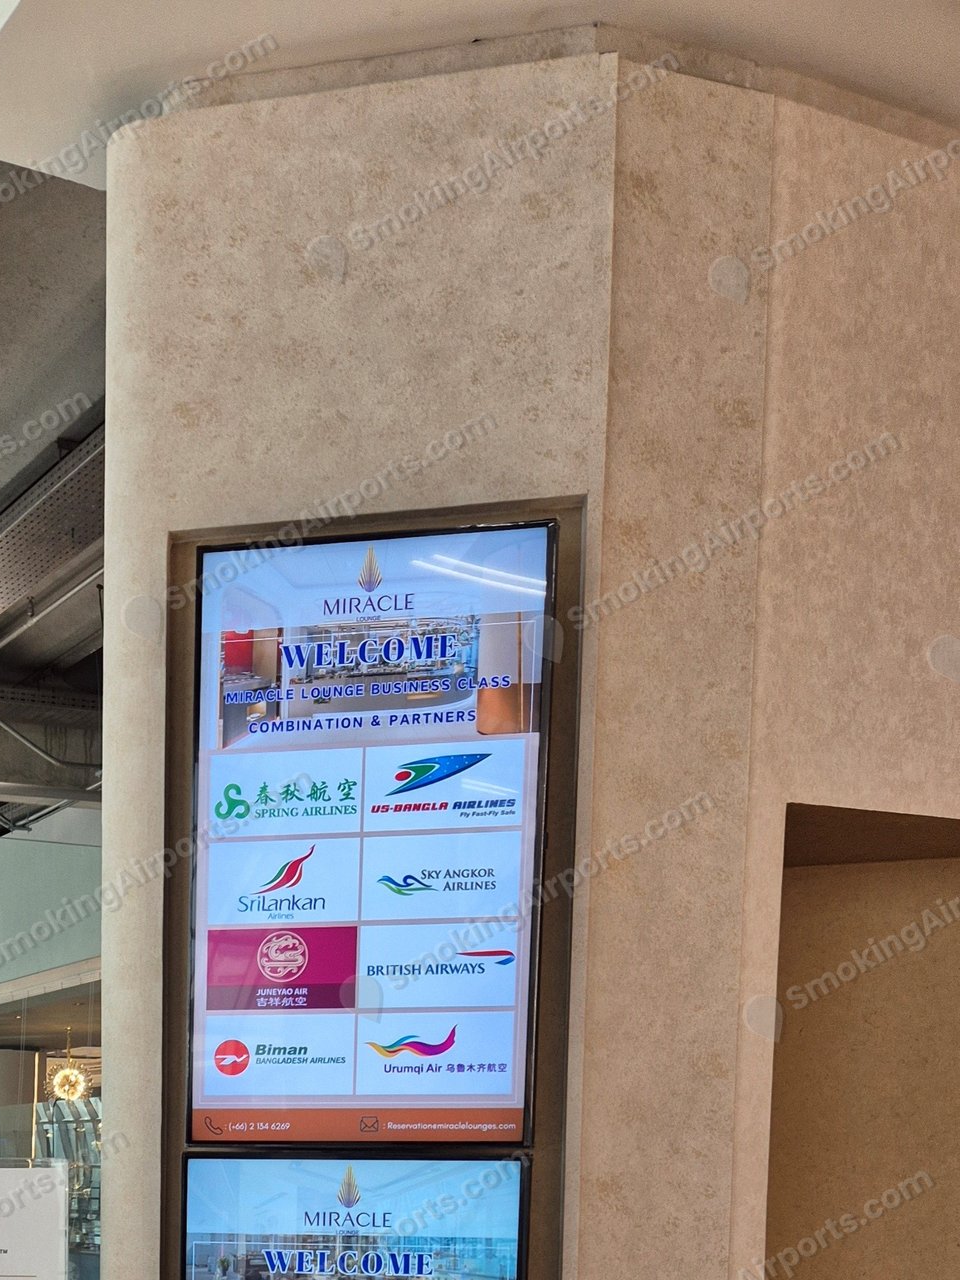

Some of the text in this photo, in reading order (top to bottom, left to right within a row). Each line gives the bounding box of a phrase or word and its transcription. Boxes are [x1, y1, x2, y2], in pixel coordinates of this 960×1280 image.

[323, 593, 415, 616] MIRACLE
[281, 633, 459, 670] WELCOME
[225, 675, 512, 704] MIRACLE LOUNGE BUSINESS CLASS
[248, 710, 477, 734] COMBINATION & PARTNERS
[254, 778, 358, 806] 春秋航空
[254, 804, 357, 820] SPRING AIRLINES
[370, 799, 516, 813] US-BANGLA AIRLINES
[420, 868, 496, 880] SKY ANGKOR
[443, 880, 497, 892] AIRLINES
[237, 894, 326, 913] SriLankan
[267, 911, 294, 920] Airlines
[367, 962, 486, 977] BRITISH AIRWAYS
[256, 987, 308, 996] JUNEYAO AIR
[254, 1043, 308, 1056] Biman
[255, 1055, 346, 1065] BANGLADESH AIRLINES
[384, 1063, 423, 1075] Urumqi
[425, 1063, 442, 1073] Air
[228, 1122, 247, 1132] (+66)
[270, 1122, 290, 1130] 6269
[304, 1211, 392, 1228] MIRACLE
[262, 1248, 434, 1276] WELCOME
